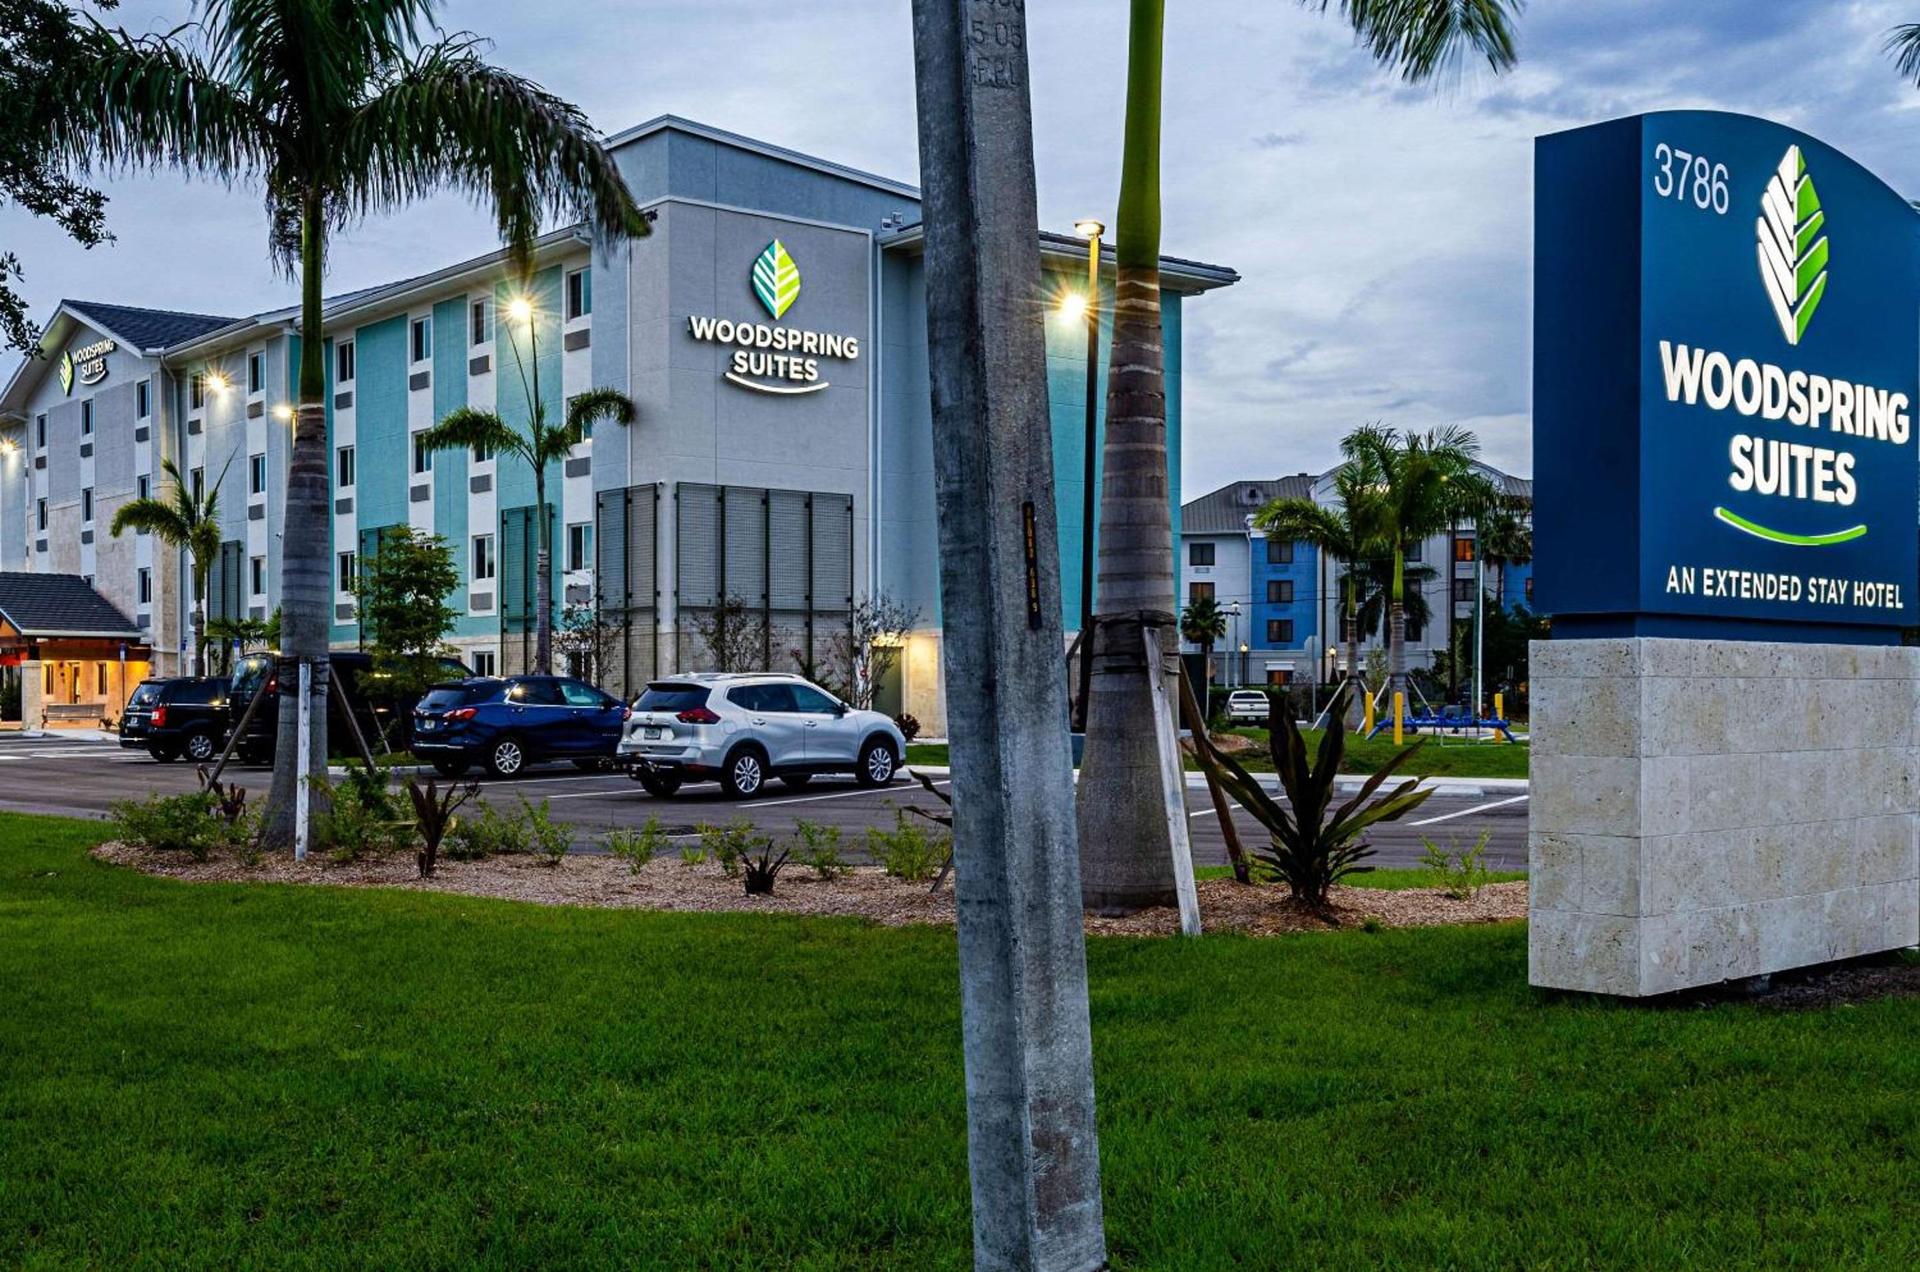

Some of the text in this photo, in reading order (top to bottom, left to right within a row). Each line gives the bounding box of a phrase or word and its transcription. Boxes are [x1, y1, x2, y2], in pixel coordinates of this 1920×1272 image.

[1654, 143, 1729, 215] 3786
[72, 338, 114, 365] WOODSPRING
[690, 315, 859, 359] WOODSPRING
[81, 357, 104, 377] SUITES
[733, 350, 819, 381] SUITES
[1659, 340, 1910, 445] WOODSPRING
[1729, 434, 1857, 506] SUITES
[1666, 565, 1904, 609] AN EXTENDED STAY HOTEL
